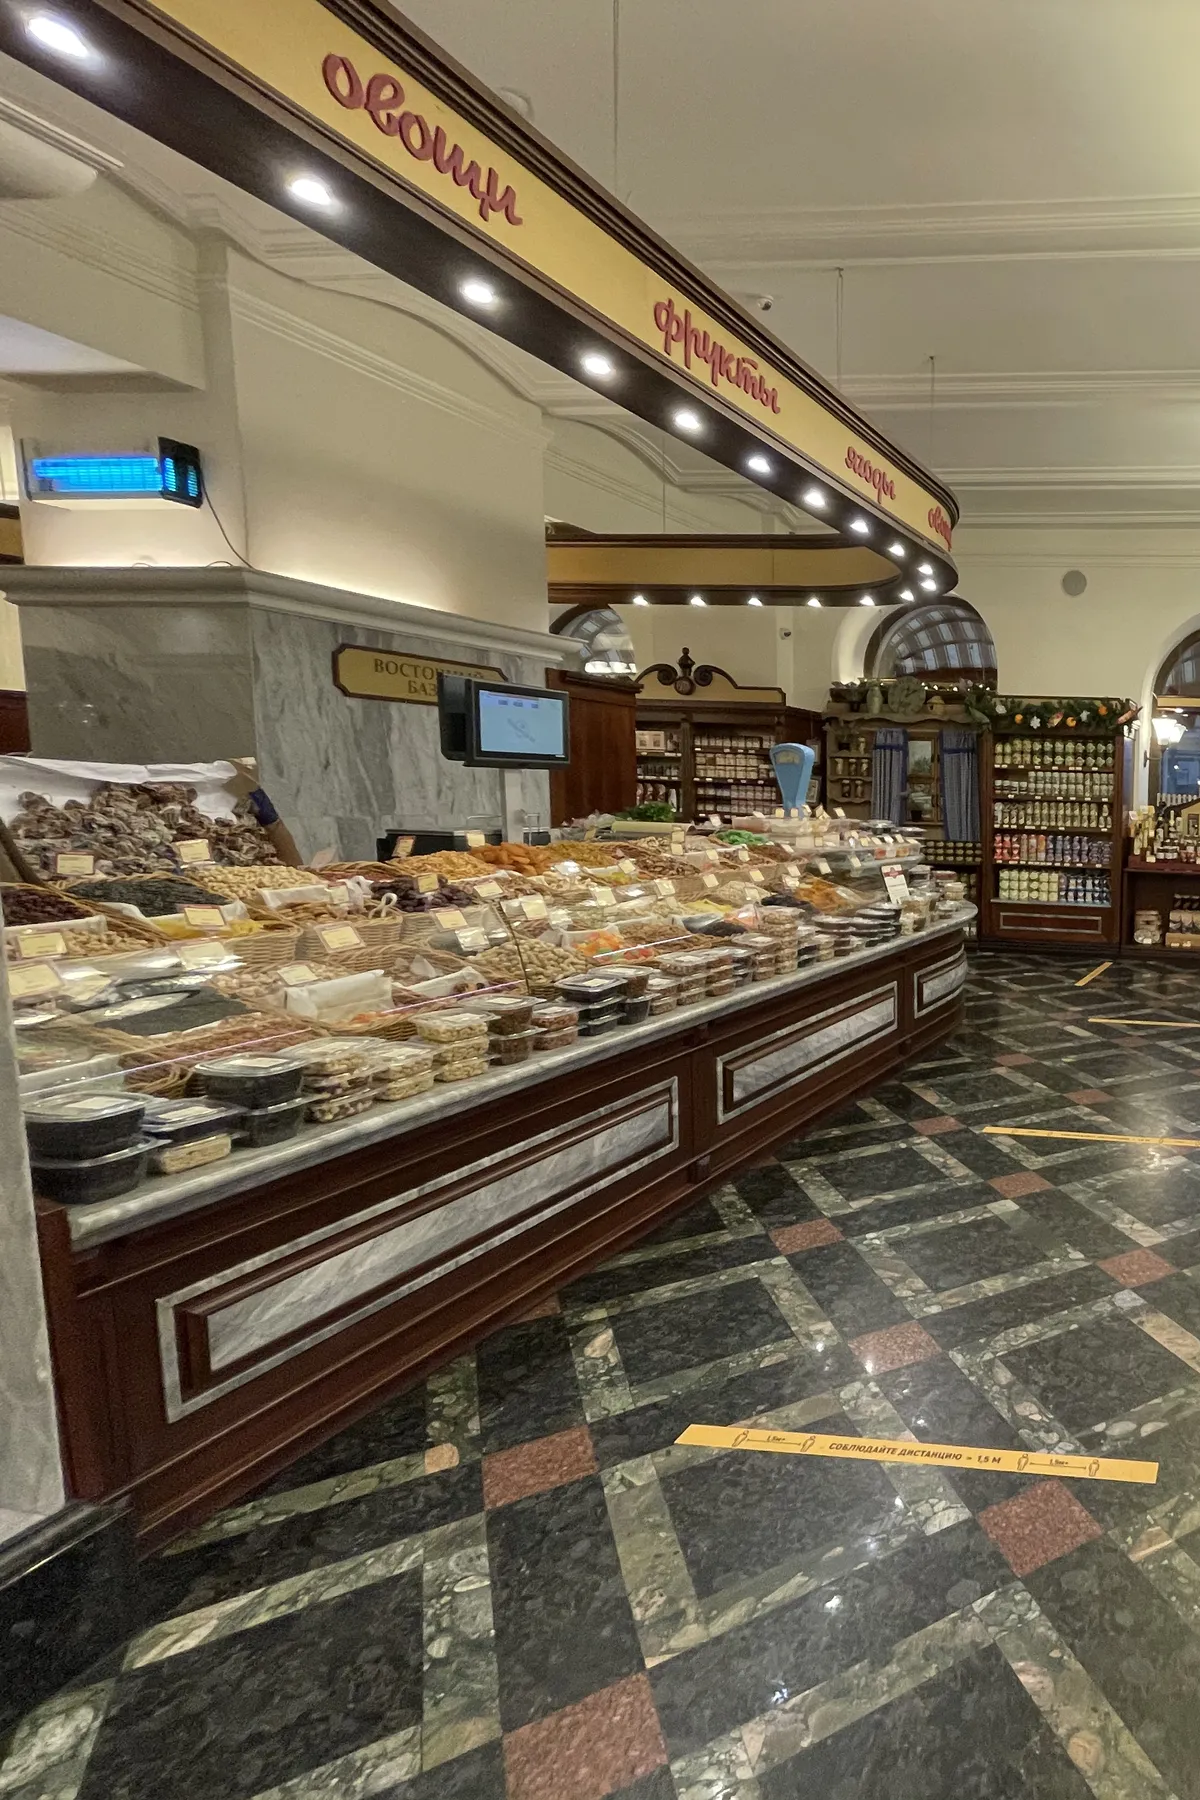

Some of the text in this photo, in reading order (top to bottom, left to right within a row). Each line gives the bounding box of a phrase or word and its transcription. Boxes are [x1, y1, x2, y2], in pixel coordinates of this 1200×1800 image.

[322, 53, 523, 226] овощи
[653, 298, 781, 414] фрукты
[928, 505, 952, 552] овощ
[374, 658, 484, 681] ВОСТО
[407, 680, 437, 696] БАЗ
[828, 1442, 897, 1455] СОБЛЮДАЙТЕ
[899, 1448, 962, 1461] ДИСТАНЦИЮ
